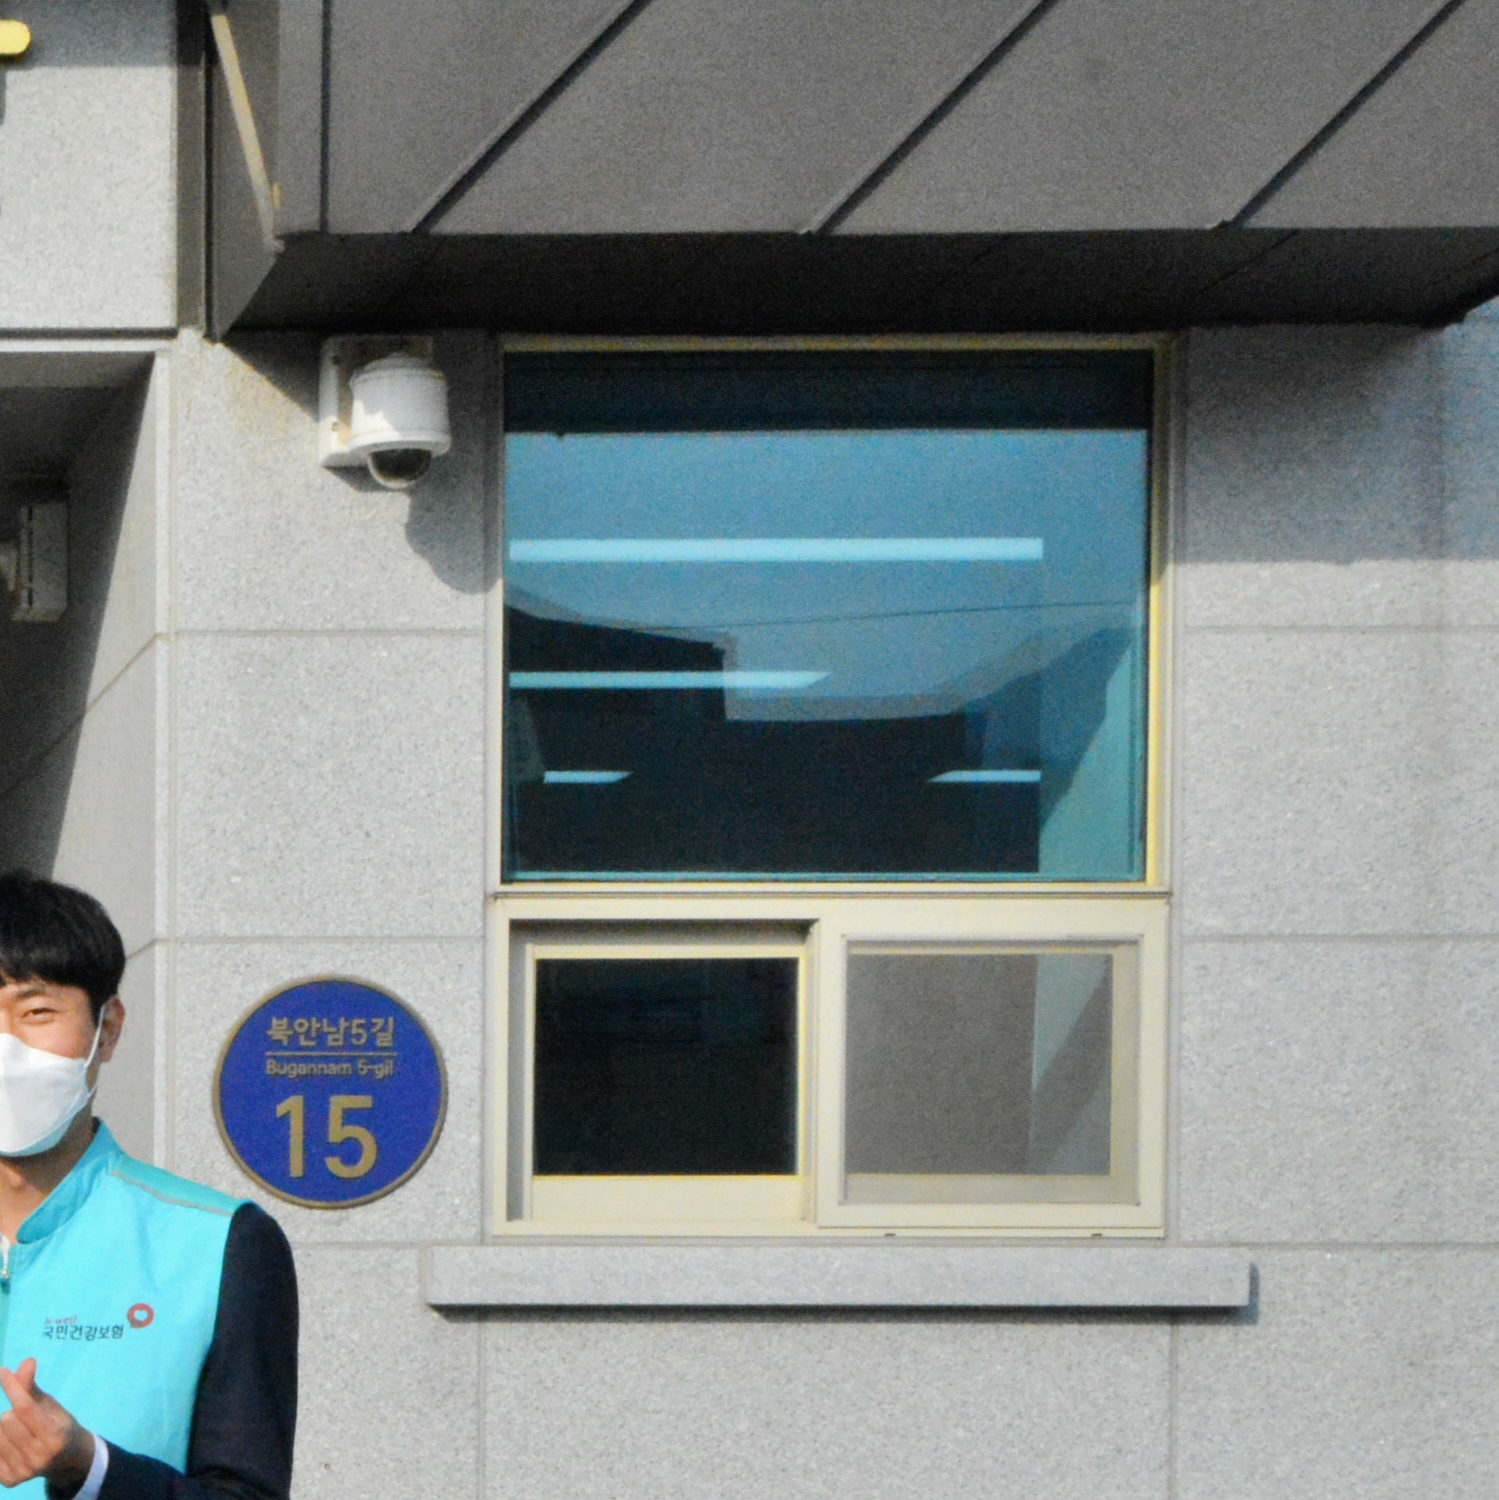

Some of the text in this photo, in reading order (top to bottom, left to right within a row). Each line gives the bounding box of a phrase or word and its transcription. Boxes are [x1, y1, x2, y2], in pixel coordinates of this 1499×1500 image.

[267, 1017, 395, 1047] 북안남5길
[266, 1060, 393, 1079] Bugannam 5-gil
[276, 1095, 378, 1178] 15
[43, 1325, 124, 1341] 국민건강보험
